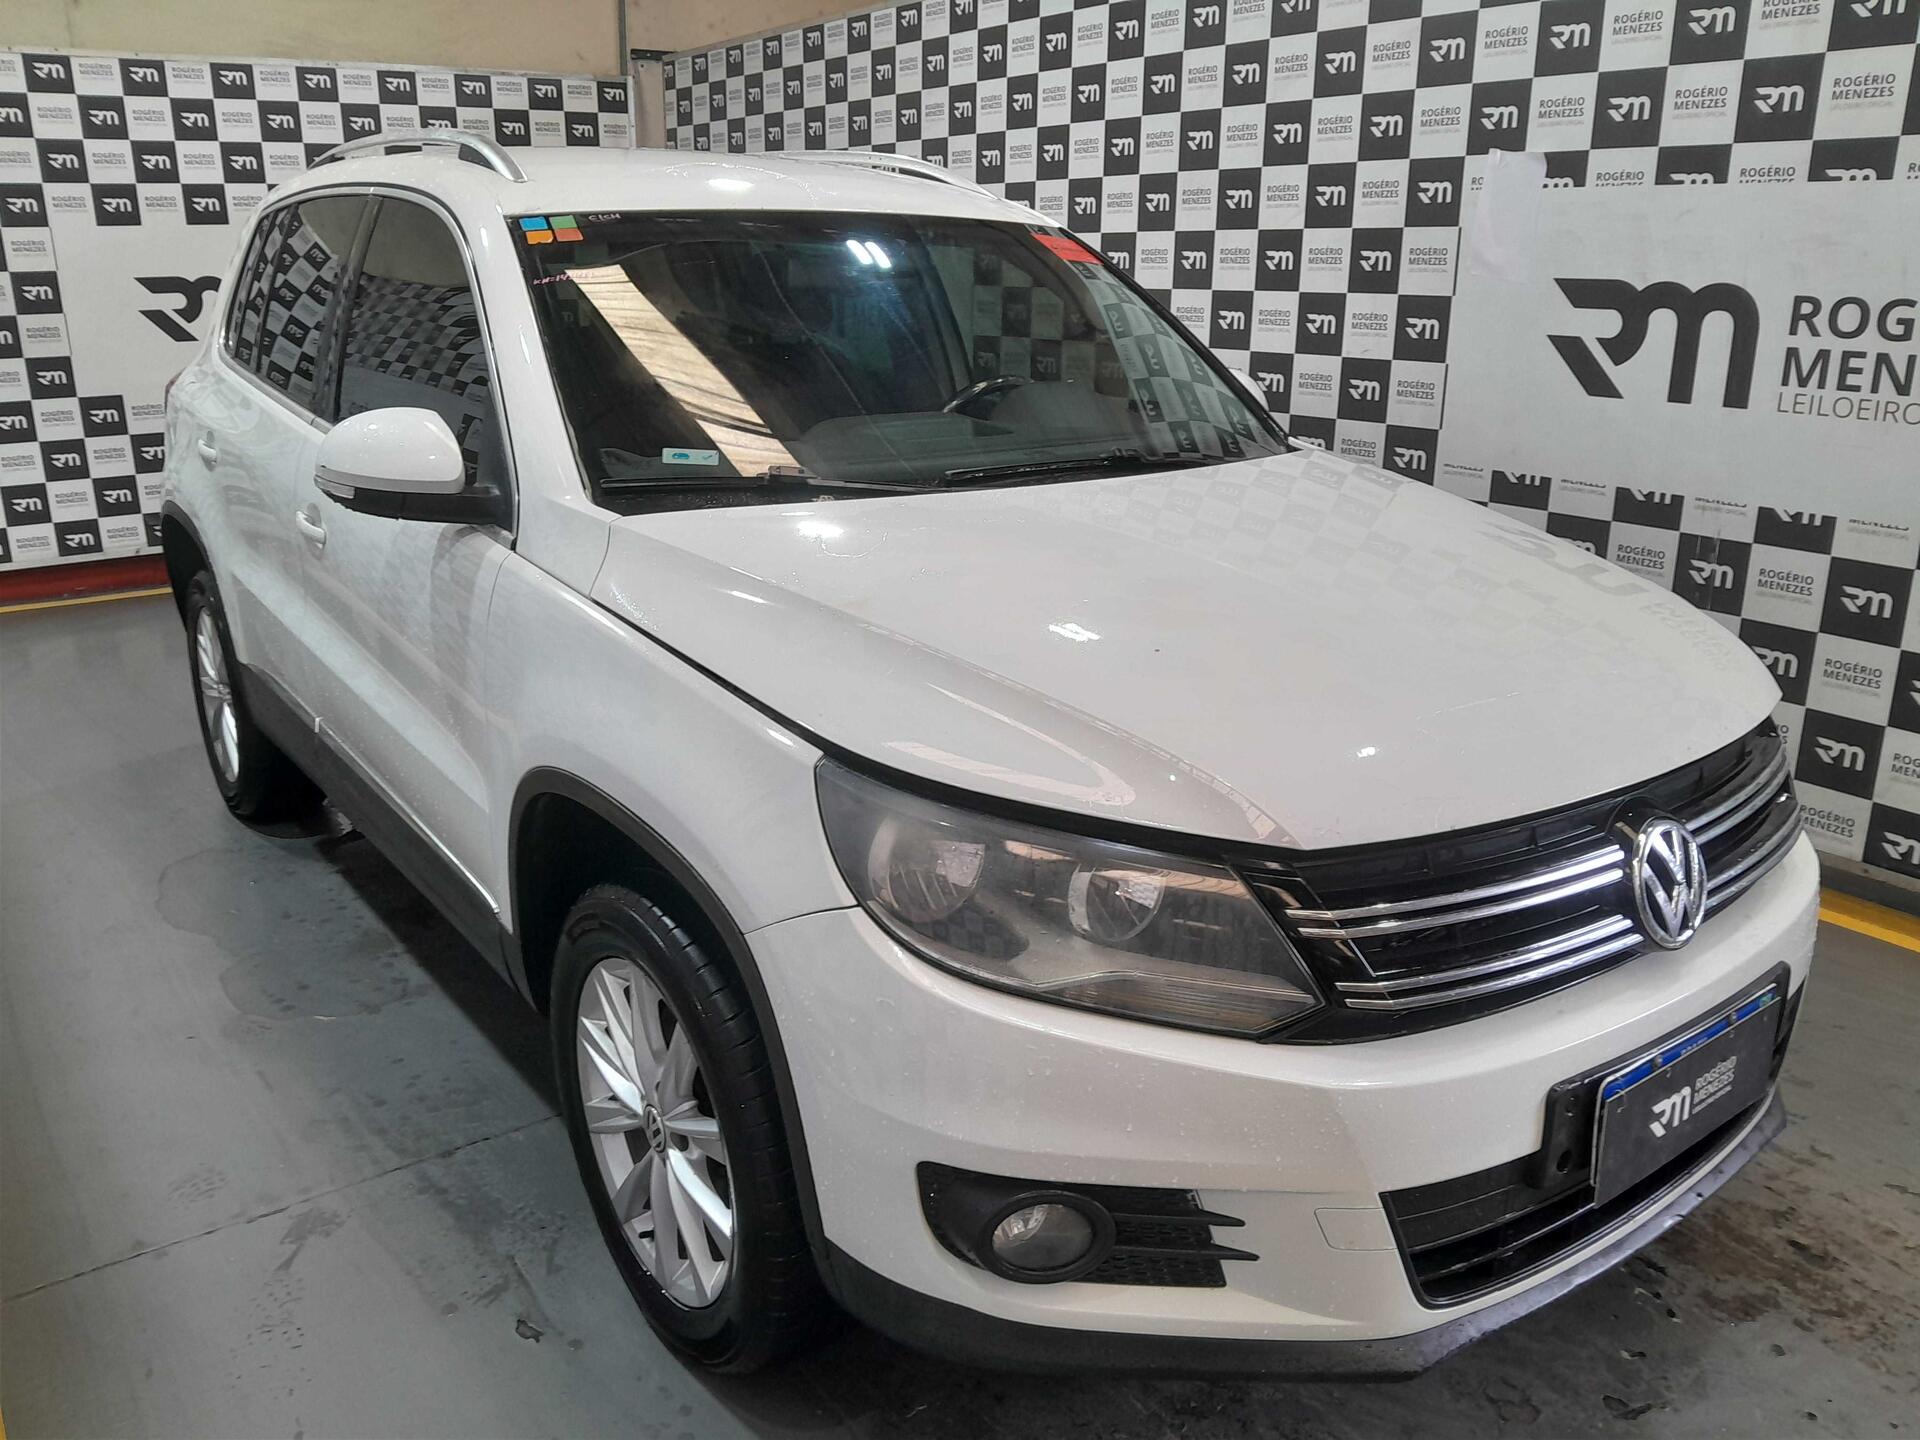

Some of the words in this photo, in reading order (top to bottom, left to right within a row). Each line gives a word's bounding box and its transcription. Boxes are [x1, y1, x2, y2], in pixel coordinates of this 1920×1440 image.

[1233, 3, 1265, 14] MENEZES
[1761, 4, 1820, 20] MENEZES
[1151, 9, 1179, 20] ROGÉRIO
[1614, 10, 1663, 24] ROGÉRIO
[1078, 23, 1103, 34] ROGÉRIO
[1151, 17, 1179, 29] MENEZES
[1612, 21, 1662, 36] MENEZES
[1078, 31, 1103, 41] MENEZES
[1484, 26, 1528, 39] ROGÉRIO
[1012, 34, 1035, 45] ROGÉRIO
[1484, 37, 1528, 49] MENEZES
[1012, 43, 1035, 52] MENEZES
[1373, 40, 1411, 52] ROGÉRIO
[1275, 54, 1308, 65] ROGÉRIO
[1372, 50, 1411, 63] MENEZES
[1188, 64, 1218, 76] ROGÉRIO
[1274, 63, 1308, 74] MENEZES
[1111, 75, 1138, 86] ROGÉRIO
[1188, 73, 1218, 84] MENEZES
[1833, 73, 1896, 88] ROGÉRIO
[1042, 85, 1066, 95] ROGÉRIO
[1111, 83, 1138, 94] MENEZES
[1675, 86, 1727, 100] ROGÉRIO
[1832, 86, 1894, 101] MENEZES
[1042, 93, 1066, 102] MENEZES
[1539, 97, 1585, 108] ROGÉRIO
[1674, 98, 1727, 111] MENEZES
[1421, 106, 1461, 118] ROGÉRIO
[1538, 107, 1585, 119] MENEZES
[1318, 116, 1352, 126] ROGÉRIO
[1420, 116, 1461, 127] MENEZES
[1226, 123, 1258, 133] ROGÉRIO
[1317, 124, 1352, 135] MENEZES
[1145, 130, 1174, 141] ROGÉRIO
[1226, 132, 1258, 142] MENEZES
[1074, 138, 1099, 147] ROGÉRIO
[1145, 138, 1174, 148] MENEZES
[1009, 144, 1032, 153] ROGÉRIO
[1074, 145, 1099, 154] MENEZES
[1009, 151, 1032, 159] MENEZES
[1596, 170, 1644, 182] ROGÉRIO
[1740, 165, 1795, 178] ROGÉRIO
[1267, 184, 1299, 193] ROGÉRIO
[1362, 180, 1399, 190] ROGÉRIO
[1107, 191, 1133, 201] ROGÉRIO
[1182, 188, 1212, 198] ROGÉRIO
[1267, 192, 1299, 202] MENEZES
[1362, 189, 1399, 199] MENEZES
[1040, 196, 1063, 204] ROGÉRIO
[1107, 199, 1133, 209] MENEZES
[1182, 196, 1212, 205] MENEZES
[1040, 203, 1063, 211] MENEZES
[1141, 247, 1168, 257] ROGÉRIO
[1219, 247, 1250, 257] ROGÉRIO
[1308, 248, 1343, 256] ROGÉRIO
[1409, 247, 1448, 256] ROGÉRIO
[1141, 256, 1168, 264] MENEZES
[1219, 255, 1250, 264] MENEZES
[1308, 256, 1343, 265] MENEZES
[1408, 256, 1448, 266] MENEZES
[1258, 308, 1291, 318] ROGÉRIO
[1352, 311, 1388, 323] ROGÉRIO
[1258, 316, 1290, 326] MENEZES
[1351, 321, 1388, 331] MENEZES
[1299, 371, 1333, 383] ROGÉRIO
[1299, 380, 1332, 391] MENEZES
[1397, 378, 1435, 391] ROGÉRIO
[1397, 389, 1435, 400] MENEZES
[1341, 437, 1376, 449] ROGÉRIO
[1341, 446, 1376, 457] MENEZES
[1616, 543, 1665, 560] ROGÉRIO
[1615, 553, 1665, 570] MENEZES
[1759, 568, 1814, 586] ROGÉRIO
[1757, 578, 1813, 596] MENEZES
[1825, 657, 1882, 678] ROGÉRIO
[1823, 668, 1881, 690] MENEZES
